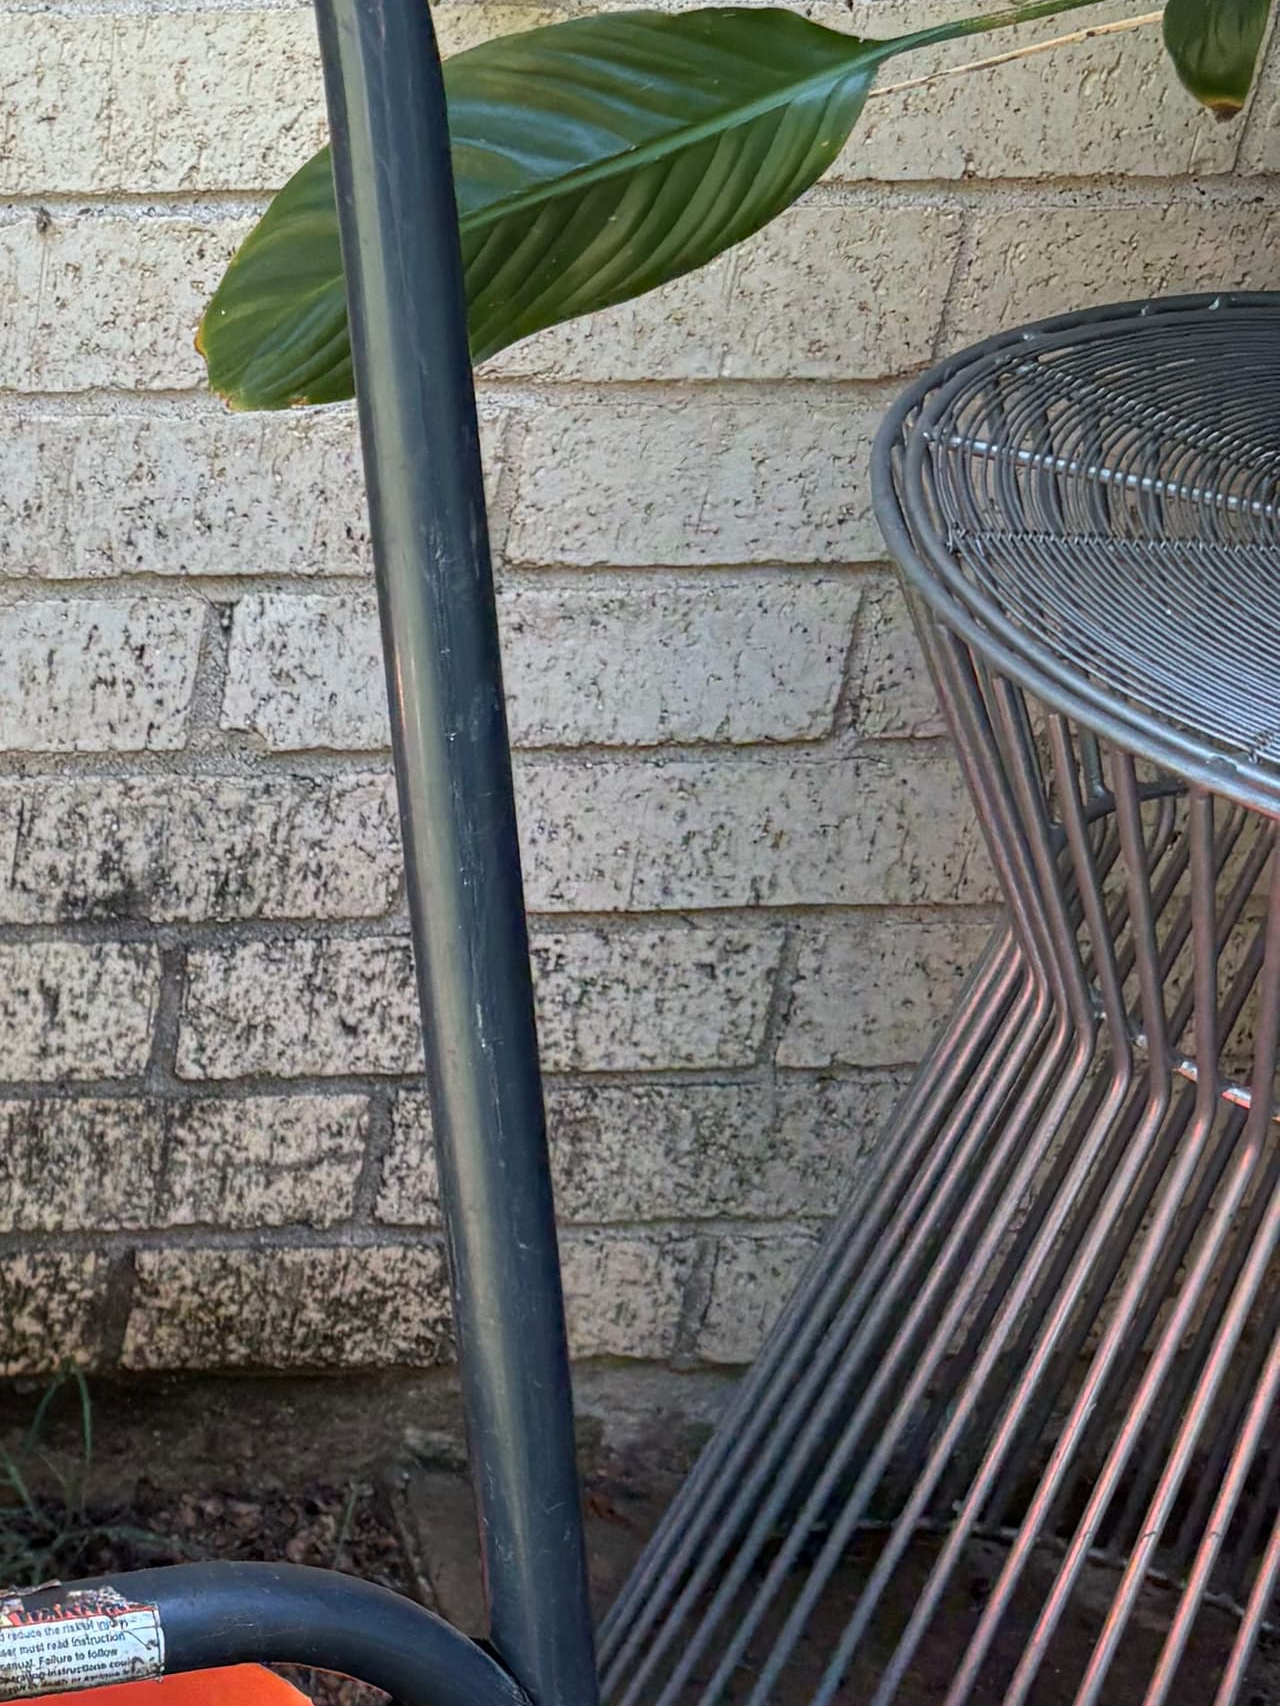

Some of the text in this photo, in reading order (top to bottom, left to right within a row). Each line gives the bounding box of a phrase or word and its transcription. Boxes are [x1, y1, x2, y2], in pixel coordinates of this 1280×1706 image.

[7, 1626, 41, 1640] reduce
[44, 1624, 61, 1636] the
[19, 1644, 44, 1656] must
[47, 1640, 69, 1651] read
[71, 1632, 126, 1647] instruction
[75, 1652, 85, 1661] to
[87, 1648, 118, 1660] follow
